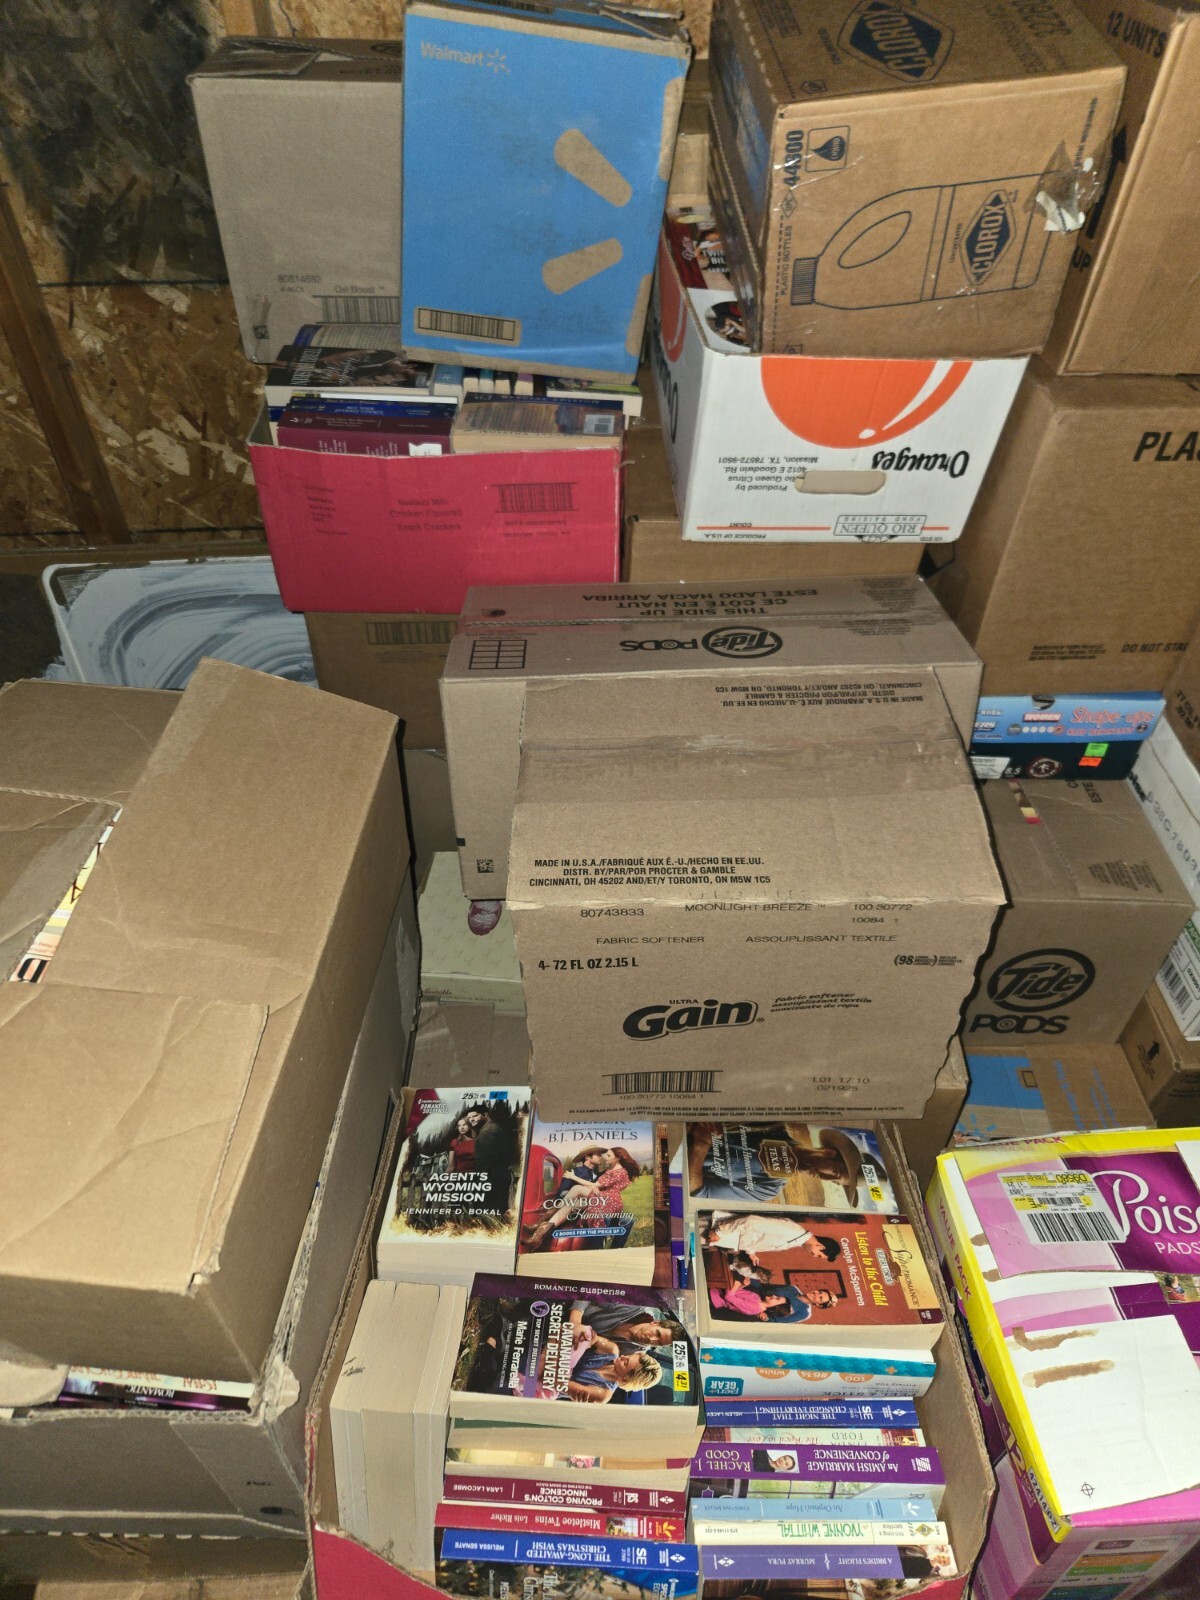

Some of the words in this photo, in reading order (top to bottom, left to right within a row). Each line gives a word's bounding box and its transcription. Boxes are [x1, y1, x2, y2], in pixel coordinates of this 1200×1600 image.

[1122, 17, 1168, 58] UNITS
[420, 42, 485, 66] Walmart
[970, 202, 1006, 274] CLOROX
[1133, 431, 1200, 462] PLA
[783, 456, 818, 465] Mission,
[872, 448, 970, 479] Oranges
[741, 465, 776, 474] Goodwin
[728, 475, 753, 483] Citrus
[754, 475, 782, 483] Queen
[748, 484, 788, 492] Produced
[840, 523, 888, 534] QUEEN
[892, 523, 917, 534] RIO
[720, 591, 767, 599] LADO
[772, 589, 818, 597] ESTE
[639, 608, 666, 616] UP
[671, 608, 717, 616] SIDE
[725, 606, 768, 615] THIS
[619, 639, 698, 652] PODS
[1121, 643, 1138, 653] DO
[534, 859, 559, 868] MADE
[561, 859, 570, 867] IN
[646, 858, 664, 867] AUX
[722, 857, 733, 865] EN
[734, 857, 765, 865] EE.UU.
[563, 868, 592, 876] DISTR.
[594, 867, 646, 876] BY/PAR/POR
[648, 867, 688, 875] PROCTER
[699, 866, 736, 874] GAMBLE
[529, 878, 581, 887] CINCINNATI,
[583, 878, 596, 886] OH
[598, 877, 624, 885] 45202
[626, 876, 665, 885] AND/ET/Y
[666, 876, 713, 885] TORONTO,
[715, 876, 728, 884] ON
[754, 875, 771, 883] 1C5
[580, 907, 645, 918] 80743833
[685, 903, 759, 912] MOONLIGHT
[763, 903, 813, 911] BREEZE
[596, 936, 638, 945] FABRIC
[642, 936, 705, 944] SOFTENER
[746, 934, 846, 942] ASSOUPLISSANT
[850, 934, 898, 942] TEXTILE
[553, 960, 567, 970] 72
[570, 960, 584, 970] FL
[587, 958, 602, 969] OZ
[605, 957, 629, 968] 2.15
[632, 957, 640, 967] L
[995, 957, 1091, 1005] Tide
[809, 992, 856, 1001] softener
[622, 998, 759, 1041] Gain
[969, 1013, 1070, 1036] PODS
[548, 1133, 568, 1143] B.J.
[573, 1131, 638, 1142] DANIELS
[711, 1133, 724, 1156] Allison
[768, 1147, 779, 1171] TEXAS
[709, 1157, 727, 1176] Leigh
[429, 1172, 489, 1183] AGENT'S
[422, 1182, 492, 1193] WYOMING
[425, 1193, 486, 1203] MISSION
[542, 1195, 609, 1210] COWBOY
[1088, 1170, 1200, 1238] Pois
[405, 1208, 452, 1216] JENNIFER
[468, 1208, 502, 1217] BOKAL
[566, 1207, 635, 1226] Homecoming
[855, 1231, 871, 1255] Listen
[939, 1198, 956, 1251] VALUE
[955, 1253, 972, 1302] PACK
[840, 1237, 854, 1264] Carolyn
[848, 1265, 865, 1306] McSparren
[865, 1267, 879, 1280] the
[534, 1284, 578, 1293] ROMANTIC
[580, 1287, 626, 1297] suspense
[869, 1282, 889, 1306] Child
[548, 1304, 563, 1340] SECRET
[513, 1321, 529, 1345] Marie
[533, 1329, 542, 1347] SECRET
[556, 1321, 575, 1392] CAVANAUGH'S
[508, 1346, 525, 1389] Ferrarella
[529, 1349, 539, 1378] DELIVERIES
[542, 1342, 560, 1391] DELIVERY
[759, 1368, 787, 1376] White
[125, 1384, 175, 1398] ROMANTIC
[711, 1379, 737, 1391] GEAR
[759, 1406, 814, 1414] EVERYTHING
[814, 1406, 847, 1414] CHANGED
[823, 1412, 836, 1420] THE
[862, 1405, 873, 1419] SE
[831, 1431, 863, 1441] FORD
[705, 1449, 740, 1461] GOOD
[813, 1448, 881, 1461] CONVENIENCE
[881, 1449, 890, 1463] of
[707, 1460, 751, 1473] RACHEL
[806, 1461, 855, 1472] MARRIAGE
[857, 1461, 886, 1473] AMISH
[888, 1462, 899, 1473] An
[453, 1484, 485, 1492] LACOMBE
[540, 1487, 588, 1498] INNOCENCE
[524, 1493, 565, 1505] COLTON'S
[567, 1495, 603, 1506] PROVING
[490, 1513, 513, 1523] Richer
[513, 1515, 528, 1524] Lois
[535, 1515, 560, 1527] Twins
[562, 1517, 601, 1529] Mistletoe
[776, 1523, 820, 1539] WHITTAL
[822, 1523, 864, 1538] YVONNE
[454, 1541, 478, 1549] SENATE
[480, 1543, 505, 1551] MELISSA
[532, 1541, 555, 1552] WISH
[556, 1542, 606, 1554] CHRISTMAS
[526, 1549, 592, 1561] LONG-AWAITED
[594, 1552, 611, 1562] THE
[637, 1547, 647, 1565] SE
[767, 1557, 786, 1566] PURA
[788, 1557, 816, 1566] MURRAY
